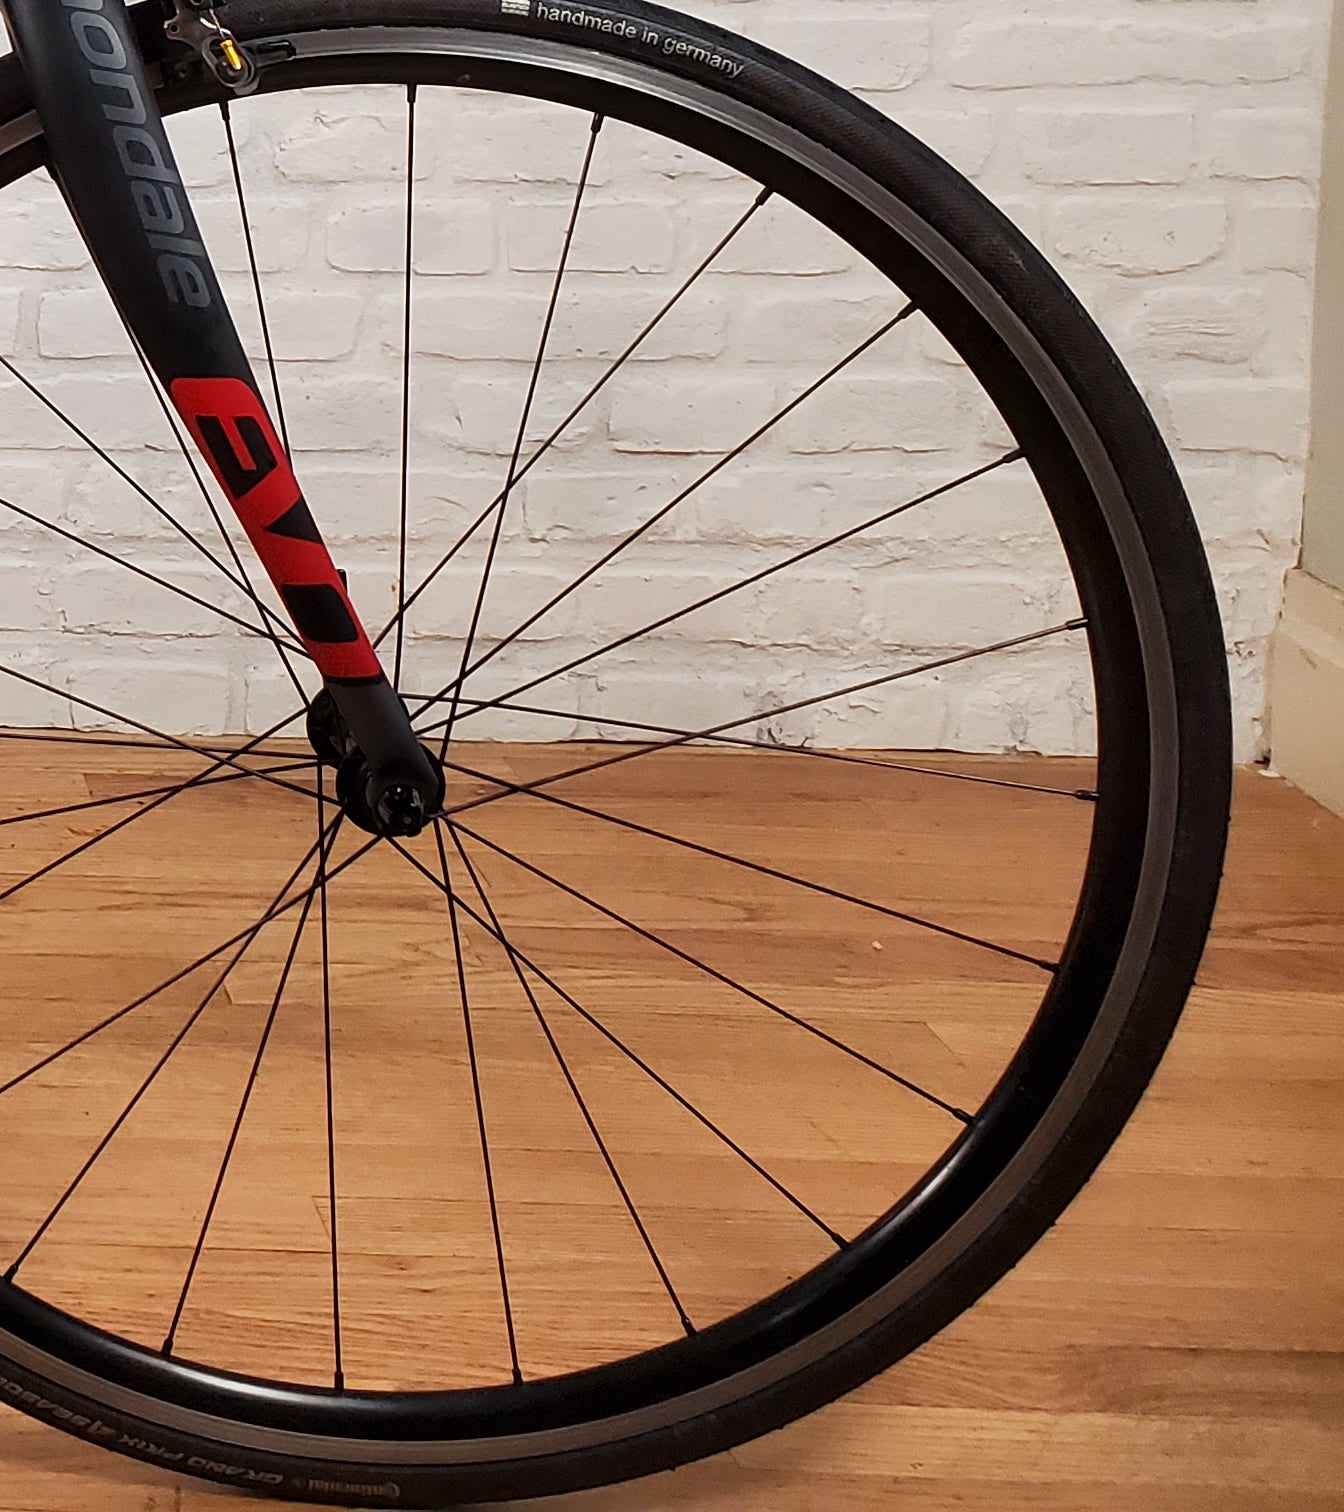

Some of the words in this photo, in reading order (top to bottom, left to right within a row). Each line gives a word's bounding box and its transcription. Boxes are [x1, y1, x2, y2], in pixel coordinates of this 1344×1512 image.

[537, 1, 638, 39] handmade
[642, 26, 659, 46] in
[662, 37, 745, 79] germany
[194, 414, 359, 644] EVO
